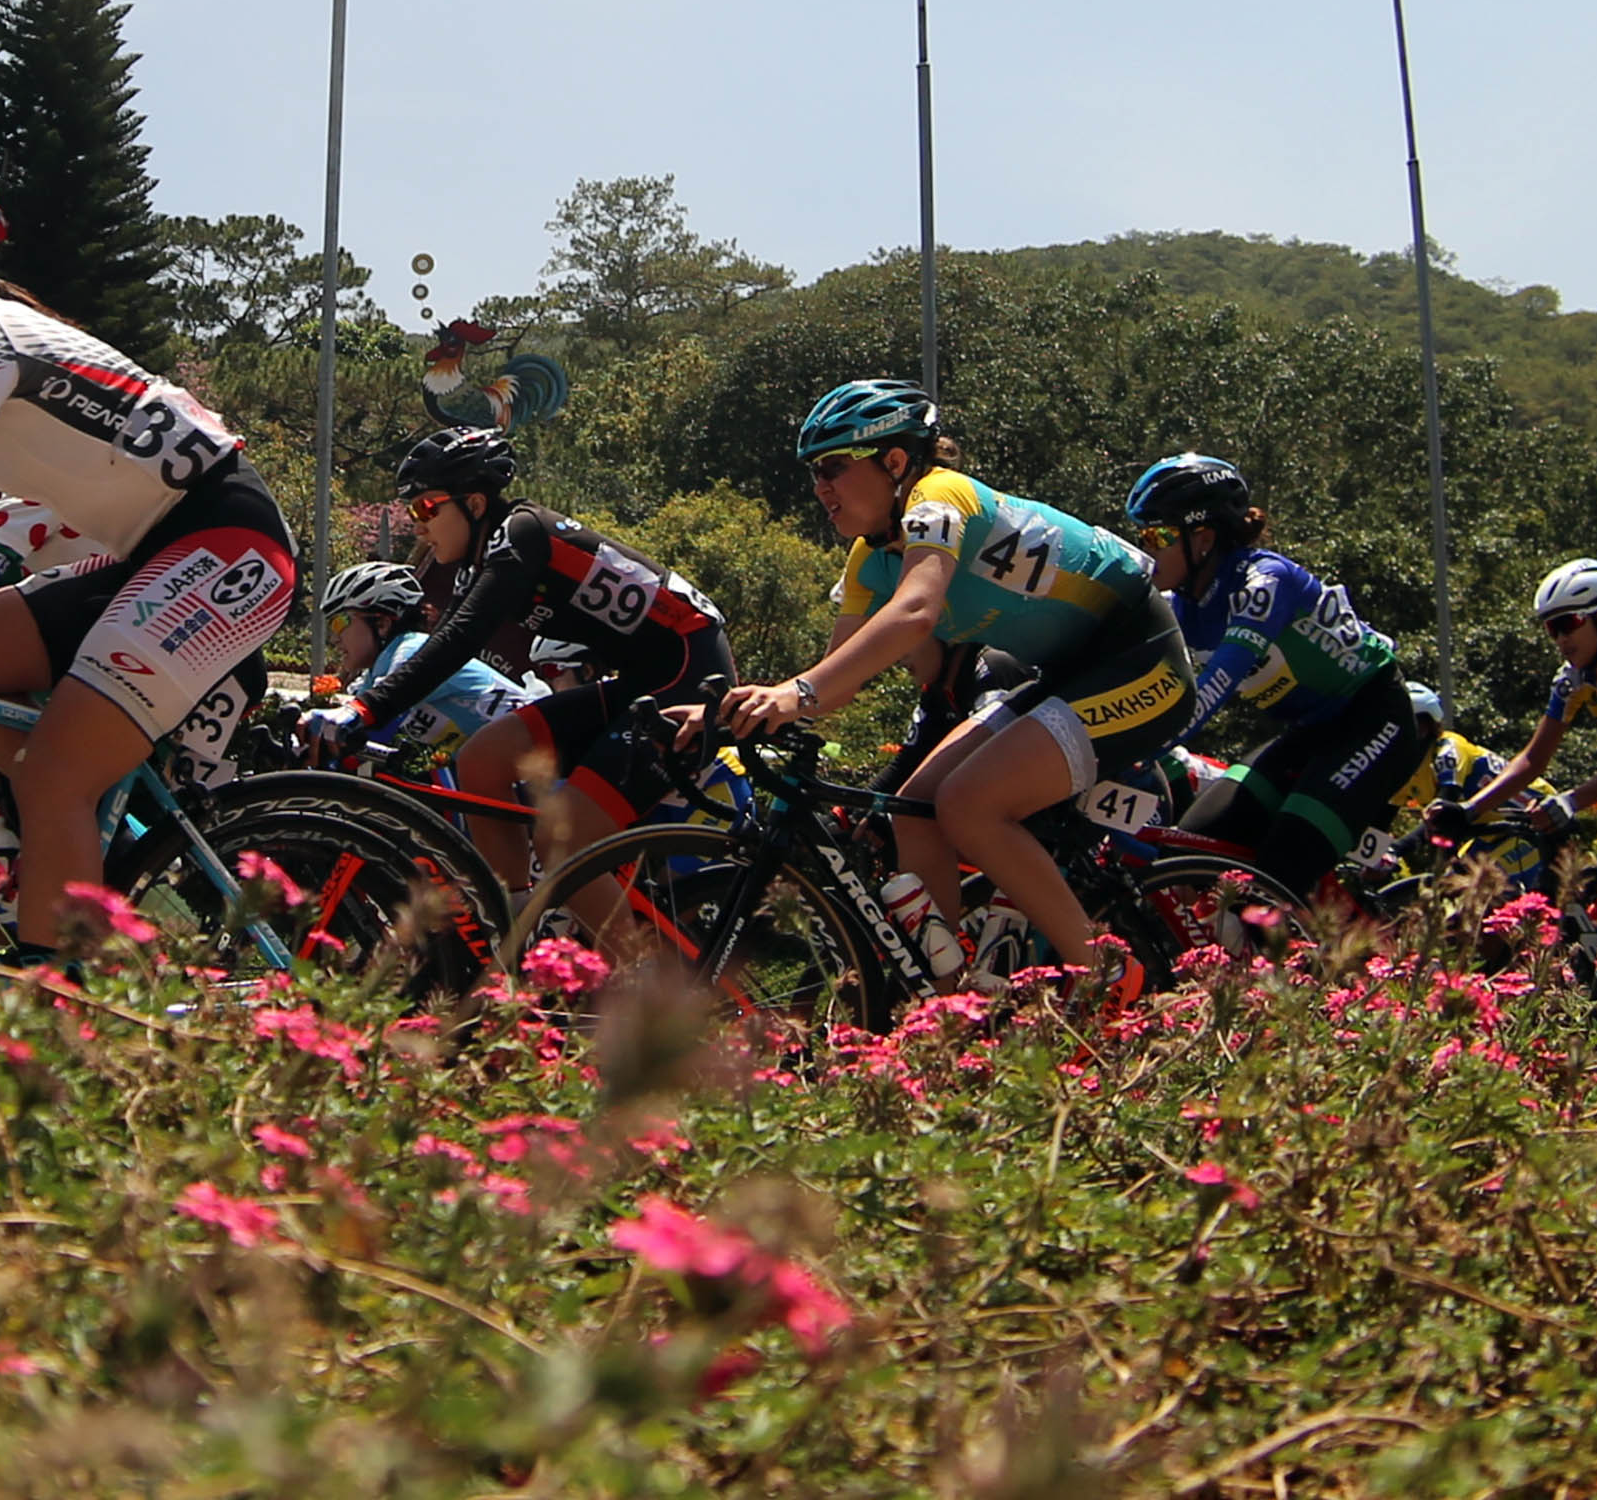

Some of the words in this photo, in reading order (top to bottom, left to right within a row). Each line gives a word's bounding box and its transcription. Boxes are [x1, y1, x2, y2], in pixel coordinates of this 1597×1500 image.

[123, 402, 220, 489] 35
[907, 513, 950, 543] 41
[979, 529, 1050, 594] 41
[229, 577, 279, 620] Kabuto
[580, 568, 647, 628] 59
[79, 655, 154, 709] ANCHOR
[1080, 666, 1181, 727] ZAKHSTAN
[186, 690, 235, 743] 35
[1329, 721, 1401, 791] BIWASE
[1096, 788, 1138, 825] 41
[816, 844, 925, 978] ARGON
